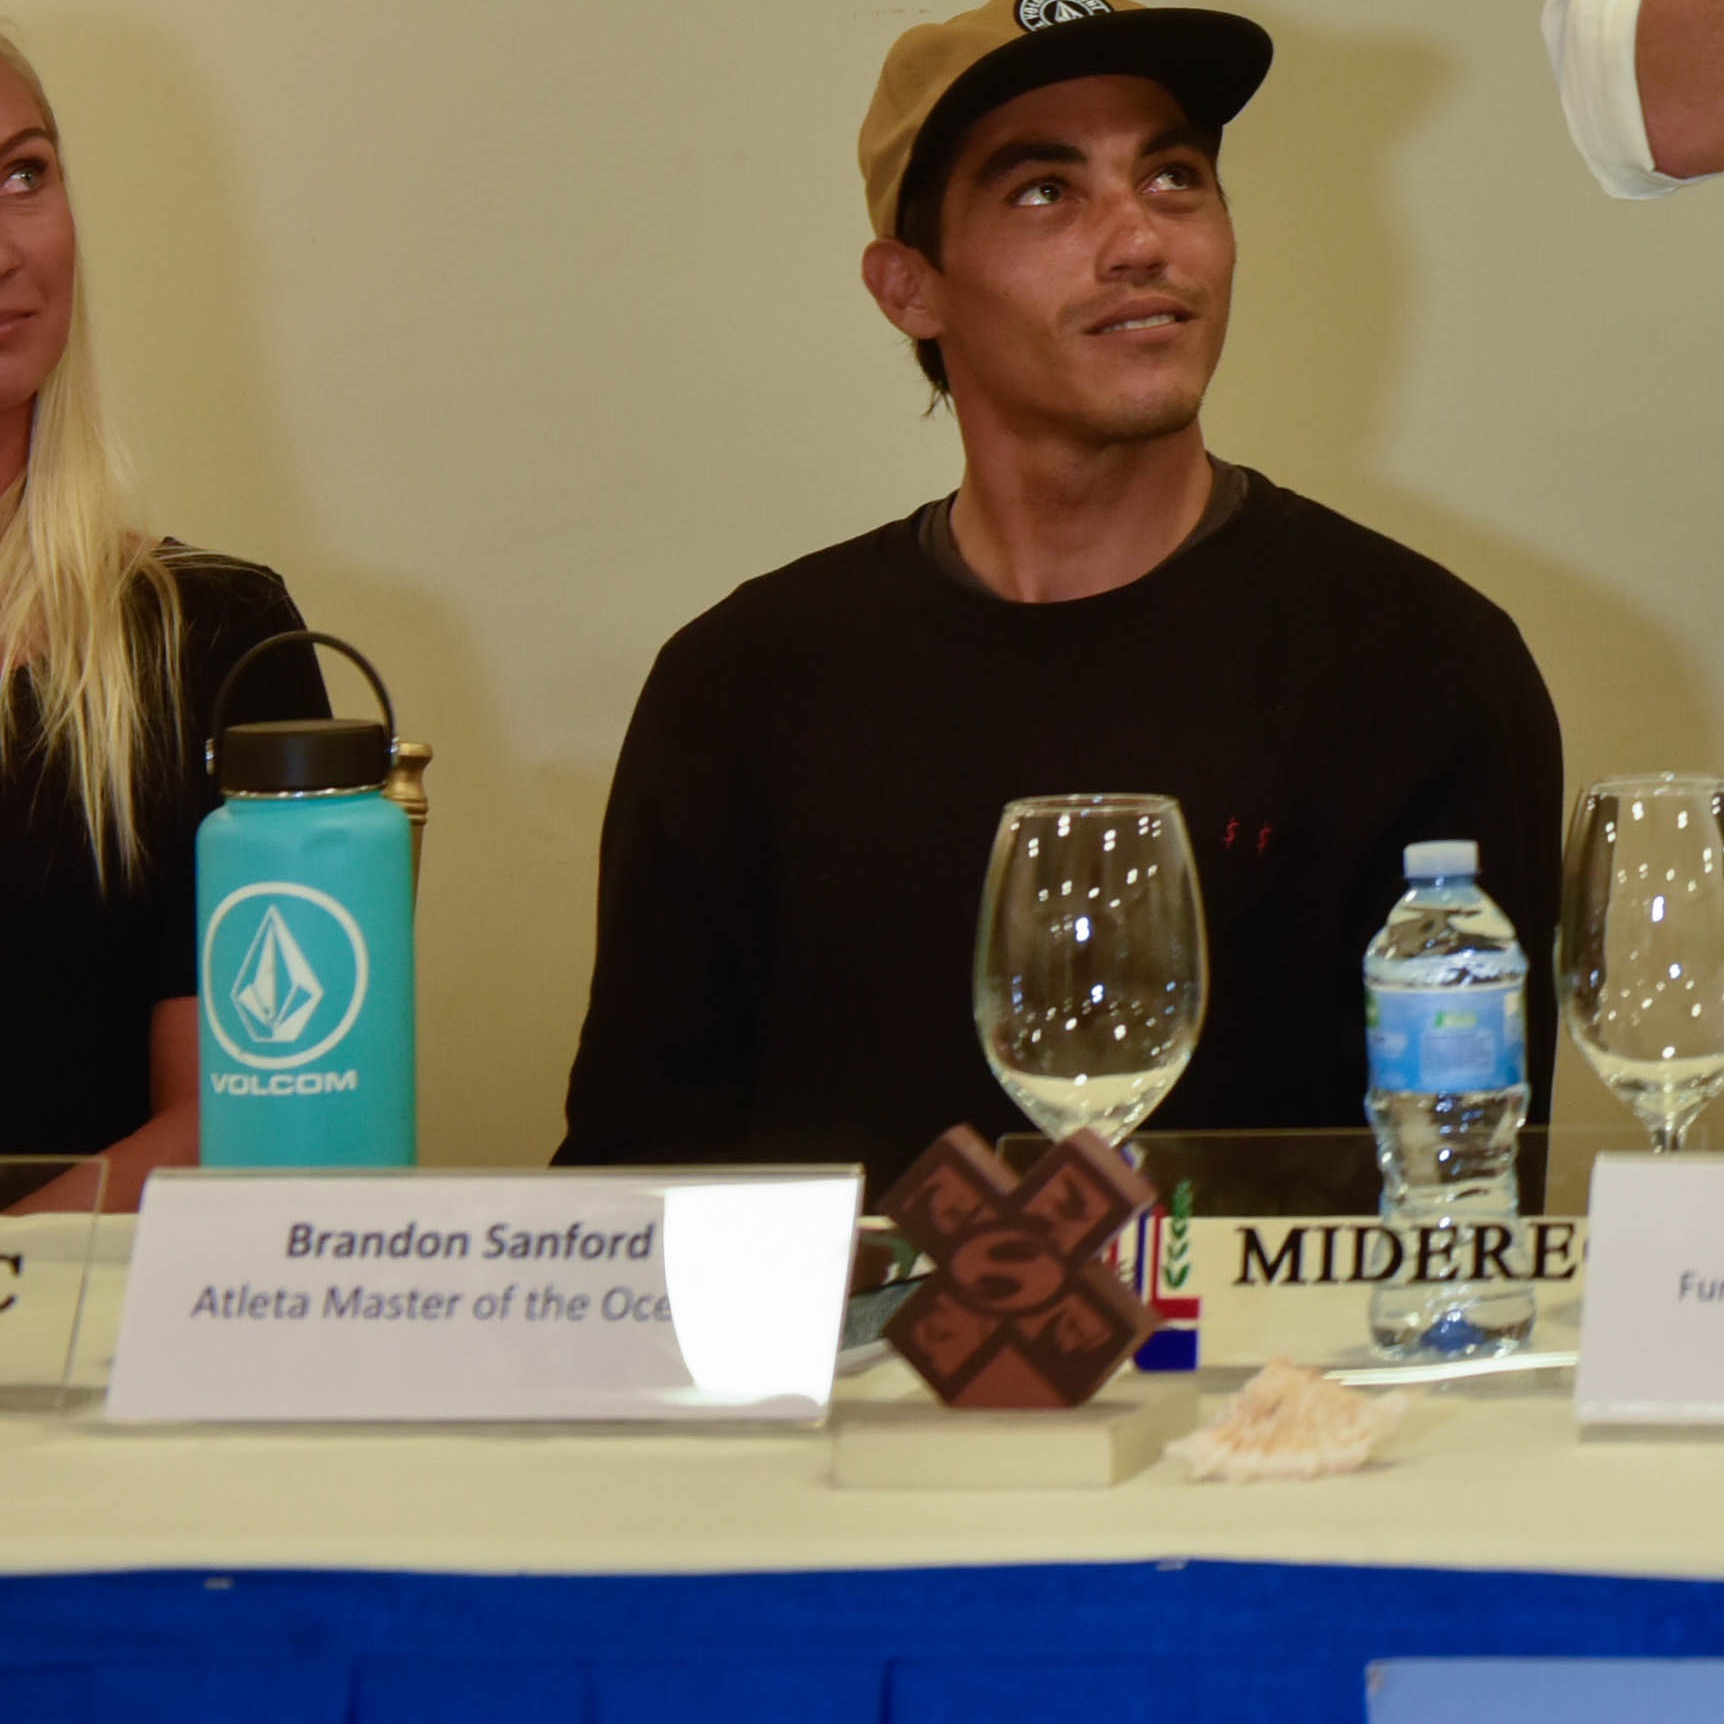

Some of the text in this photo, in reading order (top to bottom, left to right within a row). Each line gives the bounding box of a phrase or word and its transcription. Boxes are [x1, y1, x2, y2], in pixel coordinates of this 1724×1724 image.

[211, 1071, 358, 1095] VOLCOM
[286, 1222, 655, 1261] Brandon Sanford
[1234, 1223, 1583, 1287] MIDERE
[191, 1285, 673, 1323] Atleta Master of the Oce
